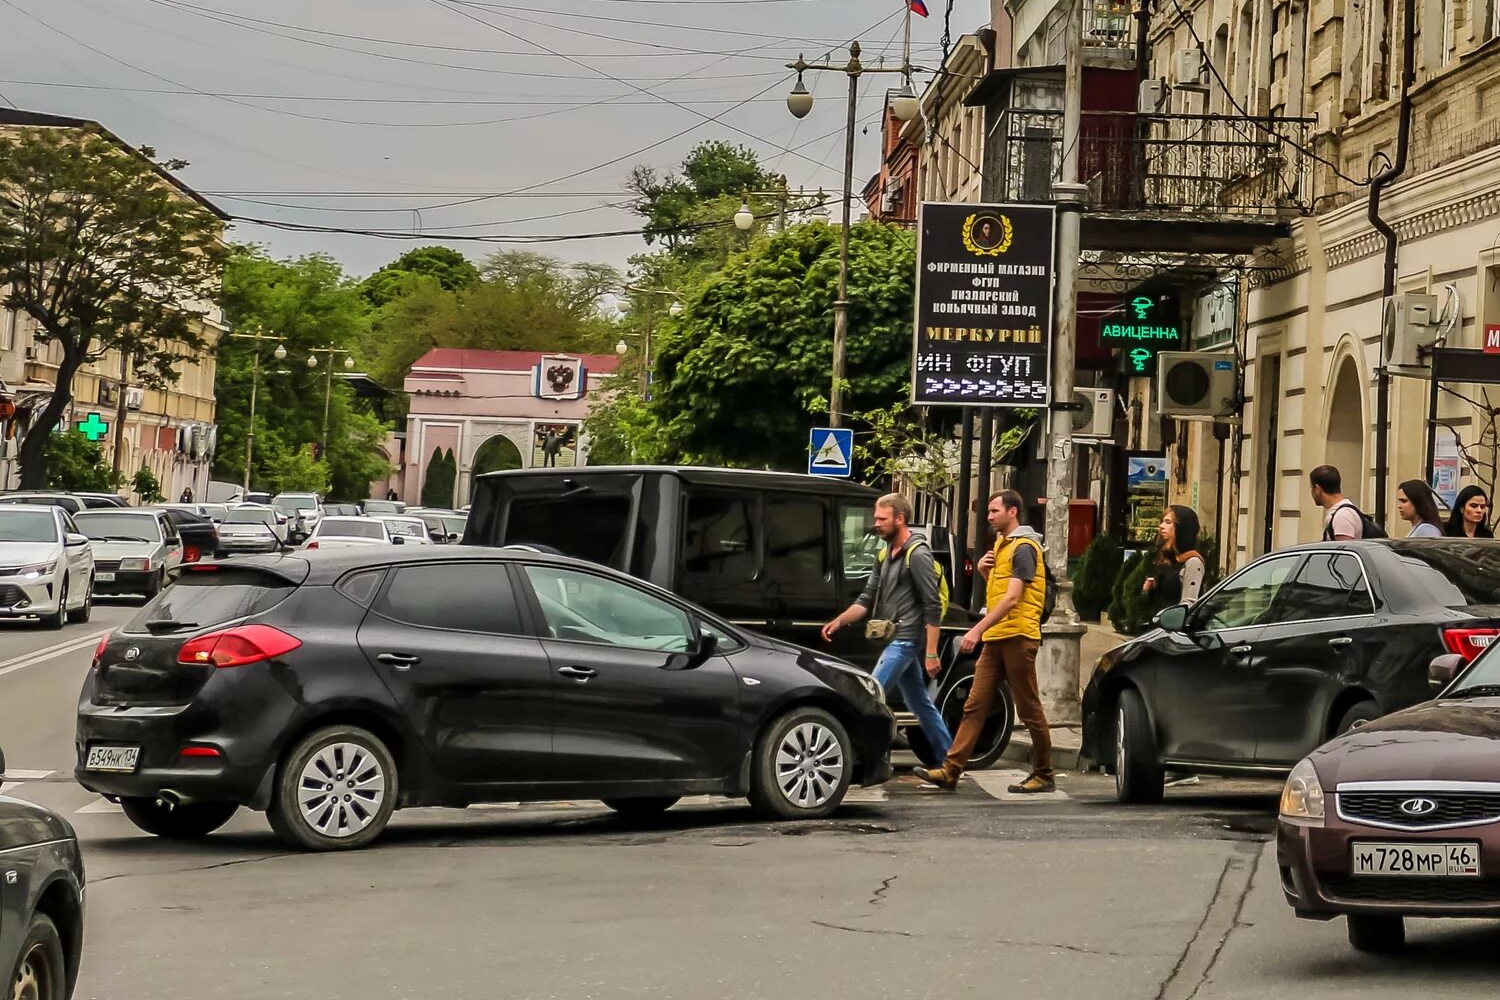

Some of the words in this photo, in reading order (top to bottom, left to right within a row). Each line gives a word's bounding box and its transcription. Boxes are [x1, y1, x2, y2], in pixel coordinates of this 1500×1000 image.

[927, 262, 995, 274] ФИРМЕННЫЙ
[998, 264, 1045, 276] МАГАЗИН
[972, 277, 1000, 288] ФГУП
[951, 289, 1019, 302] КИЗЛЯРСКИЙ
[932, 303, 998, 315] КОНЬЯЧНЫЙ
[1001, 305, 1037, 317] ЗАВОД
[926, 325, 1041, 343] МЕРКУРИЙ
[1103, 324, 1179, 340] АВИЦЕННА
[917, 353, 951, 372] ИН
[966, 354, 1031, 376] ФГУП
[125, 749, 137, 761] 134
[1450, 847, 1470, 865] 46
[1448, 865, 1465, 873] RUS
